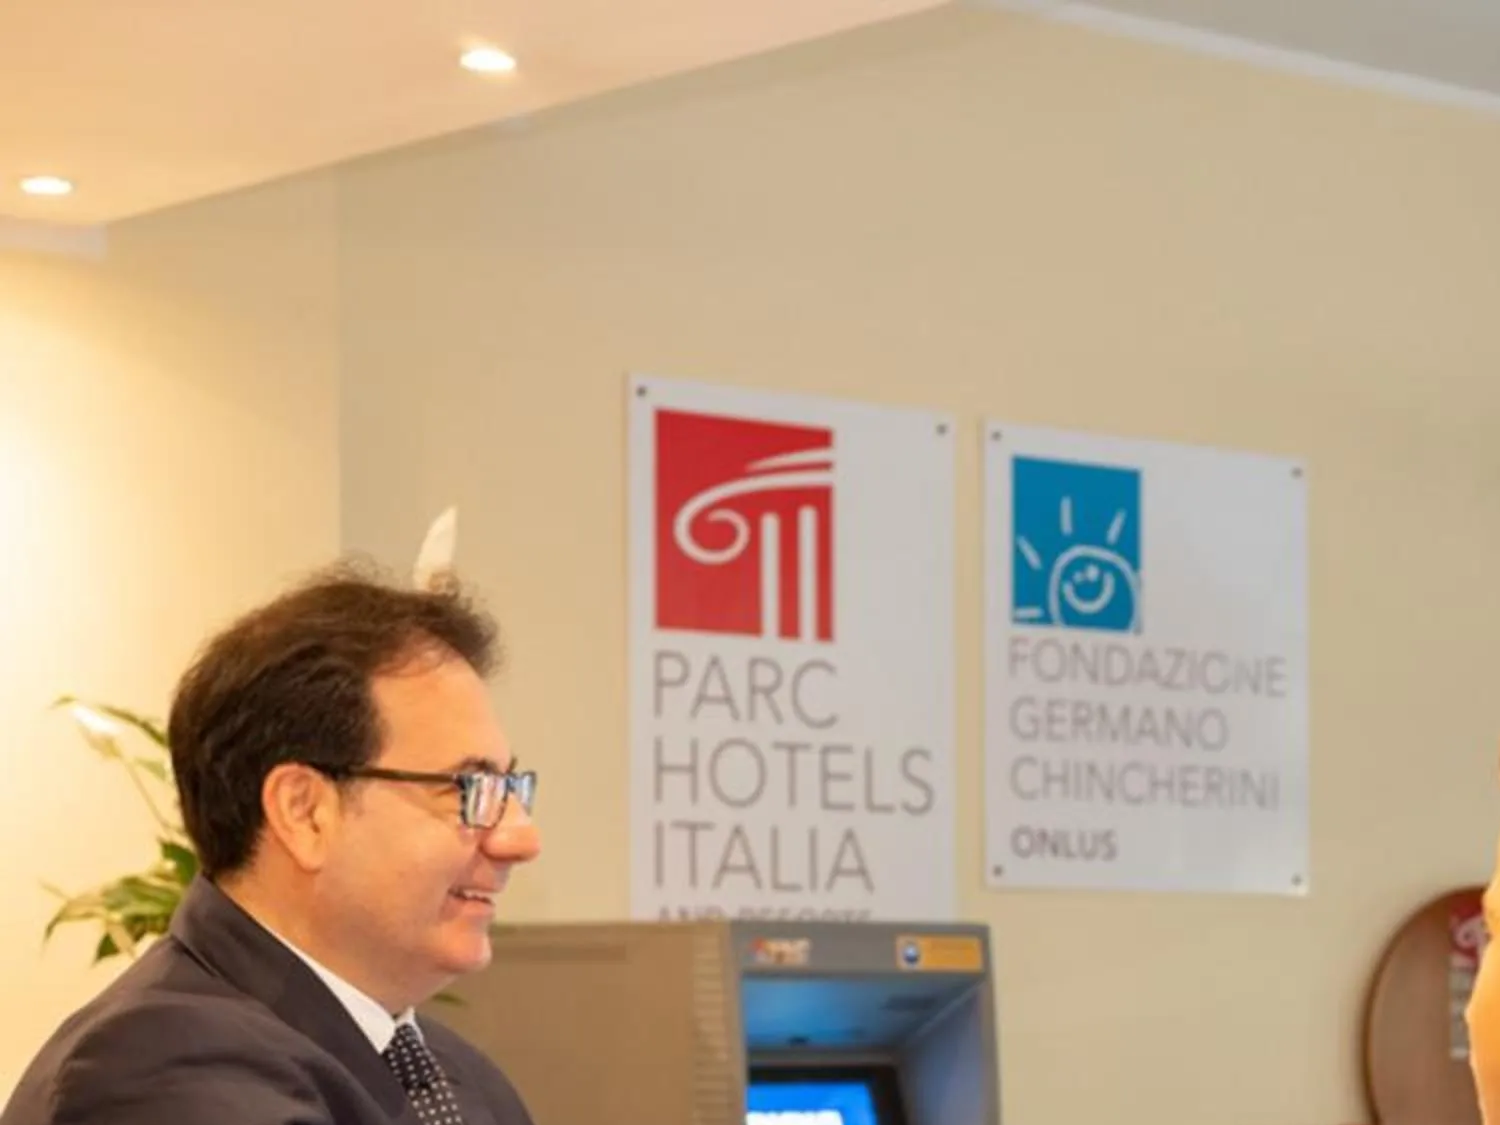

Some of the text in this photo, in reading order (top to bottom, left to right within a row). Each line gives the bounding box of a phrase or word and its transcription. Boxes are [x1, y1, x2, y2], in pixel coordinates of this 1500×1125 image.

[653, 649, 839, 730] PARC
[1009, 695, 1230, 752] GERMANO
[653, 735, 936, 817] HOTELS
[1009, 755, 1281, 811] CHINCHERINI
[654, 819, 876, 894] ITALIA
[1010, 824, 1119, 862] ONLUS
